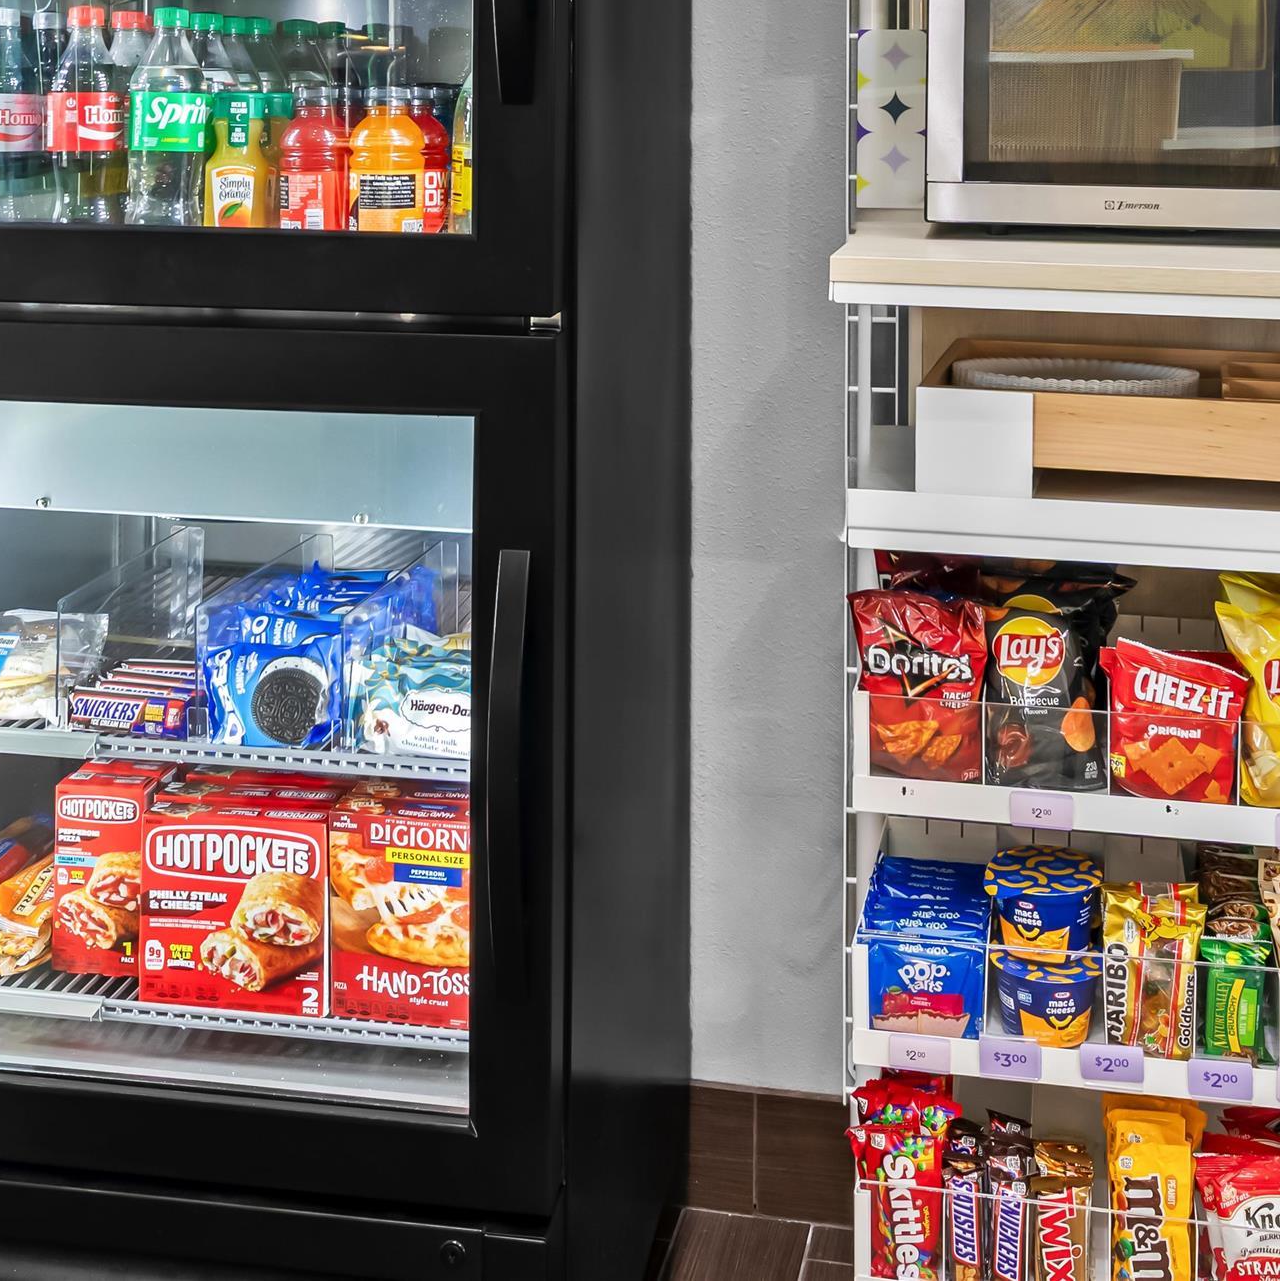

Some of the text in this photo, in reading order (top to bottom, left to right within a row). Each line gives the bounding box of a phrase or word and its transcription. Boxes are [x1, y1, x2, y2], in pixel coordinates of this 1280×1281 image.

[236, 114, 241, 122] C
[220, 177, 251, 191] Simply
[219, 187, 251, 202] Orange
[999, 635, 1061, 678] Lay's
[868, 648, 972, 680] Doritos
[942, 691, 972, 701] NACHO
[1010, 696, 1060, 706] Barbecue
[73, 698, 139, 721] SNICKERS
[91, 719, 101, 727] ICE
[101, 719, 118, 728] CREAM
[401, 739, 438, 751] chocolate
[414, 735, 439, 744] vanilla
[332, 820, 358, 828] PROTEIN
[58, 828, 100, 837] PEPPERONI
[371, 822, 470, 852] DIGIORN
[58, 835, 81, 843] PIZZA
[391, 851, 465, 865] PERSONAL SIZE
[410, 869, 445, 878] PEPPERONI
[149, 890, 228, 903] PHILLY STEAK
[149, 900, 203, 911] & CHEESE
[1014, 908, 1031, 918] mac
[121, 941, 132, 956] 1
[148, 946, 161, 958] 9g
[170, 944, 194, 952] OVER
[334, 981, 347, 990] PIZZA
[908, 979, 944, 993] tarts
[302, 987, 319, 1006] 2
[1104, 941, 1129, 1046] HARIBO
[410, 996, 449, 1007] style crust
[302, 1006, 319, 1015] PACK
[1178, 973, 1194, 1048] Goldbears
[1228, 995, 1238, 1036] CRUNCHY
[1167, 1179, 1177, 1207] PEANUT
[884, 1154, 920, 1281] Skittles
[996, 1188, 1023, 1280] SNICKERS
